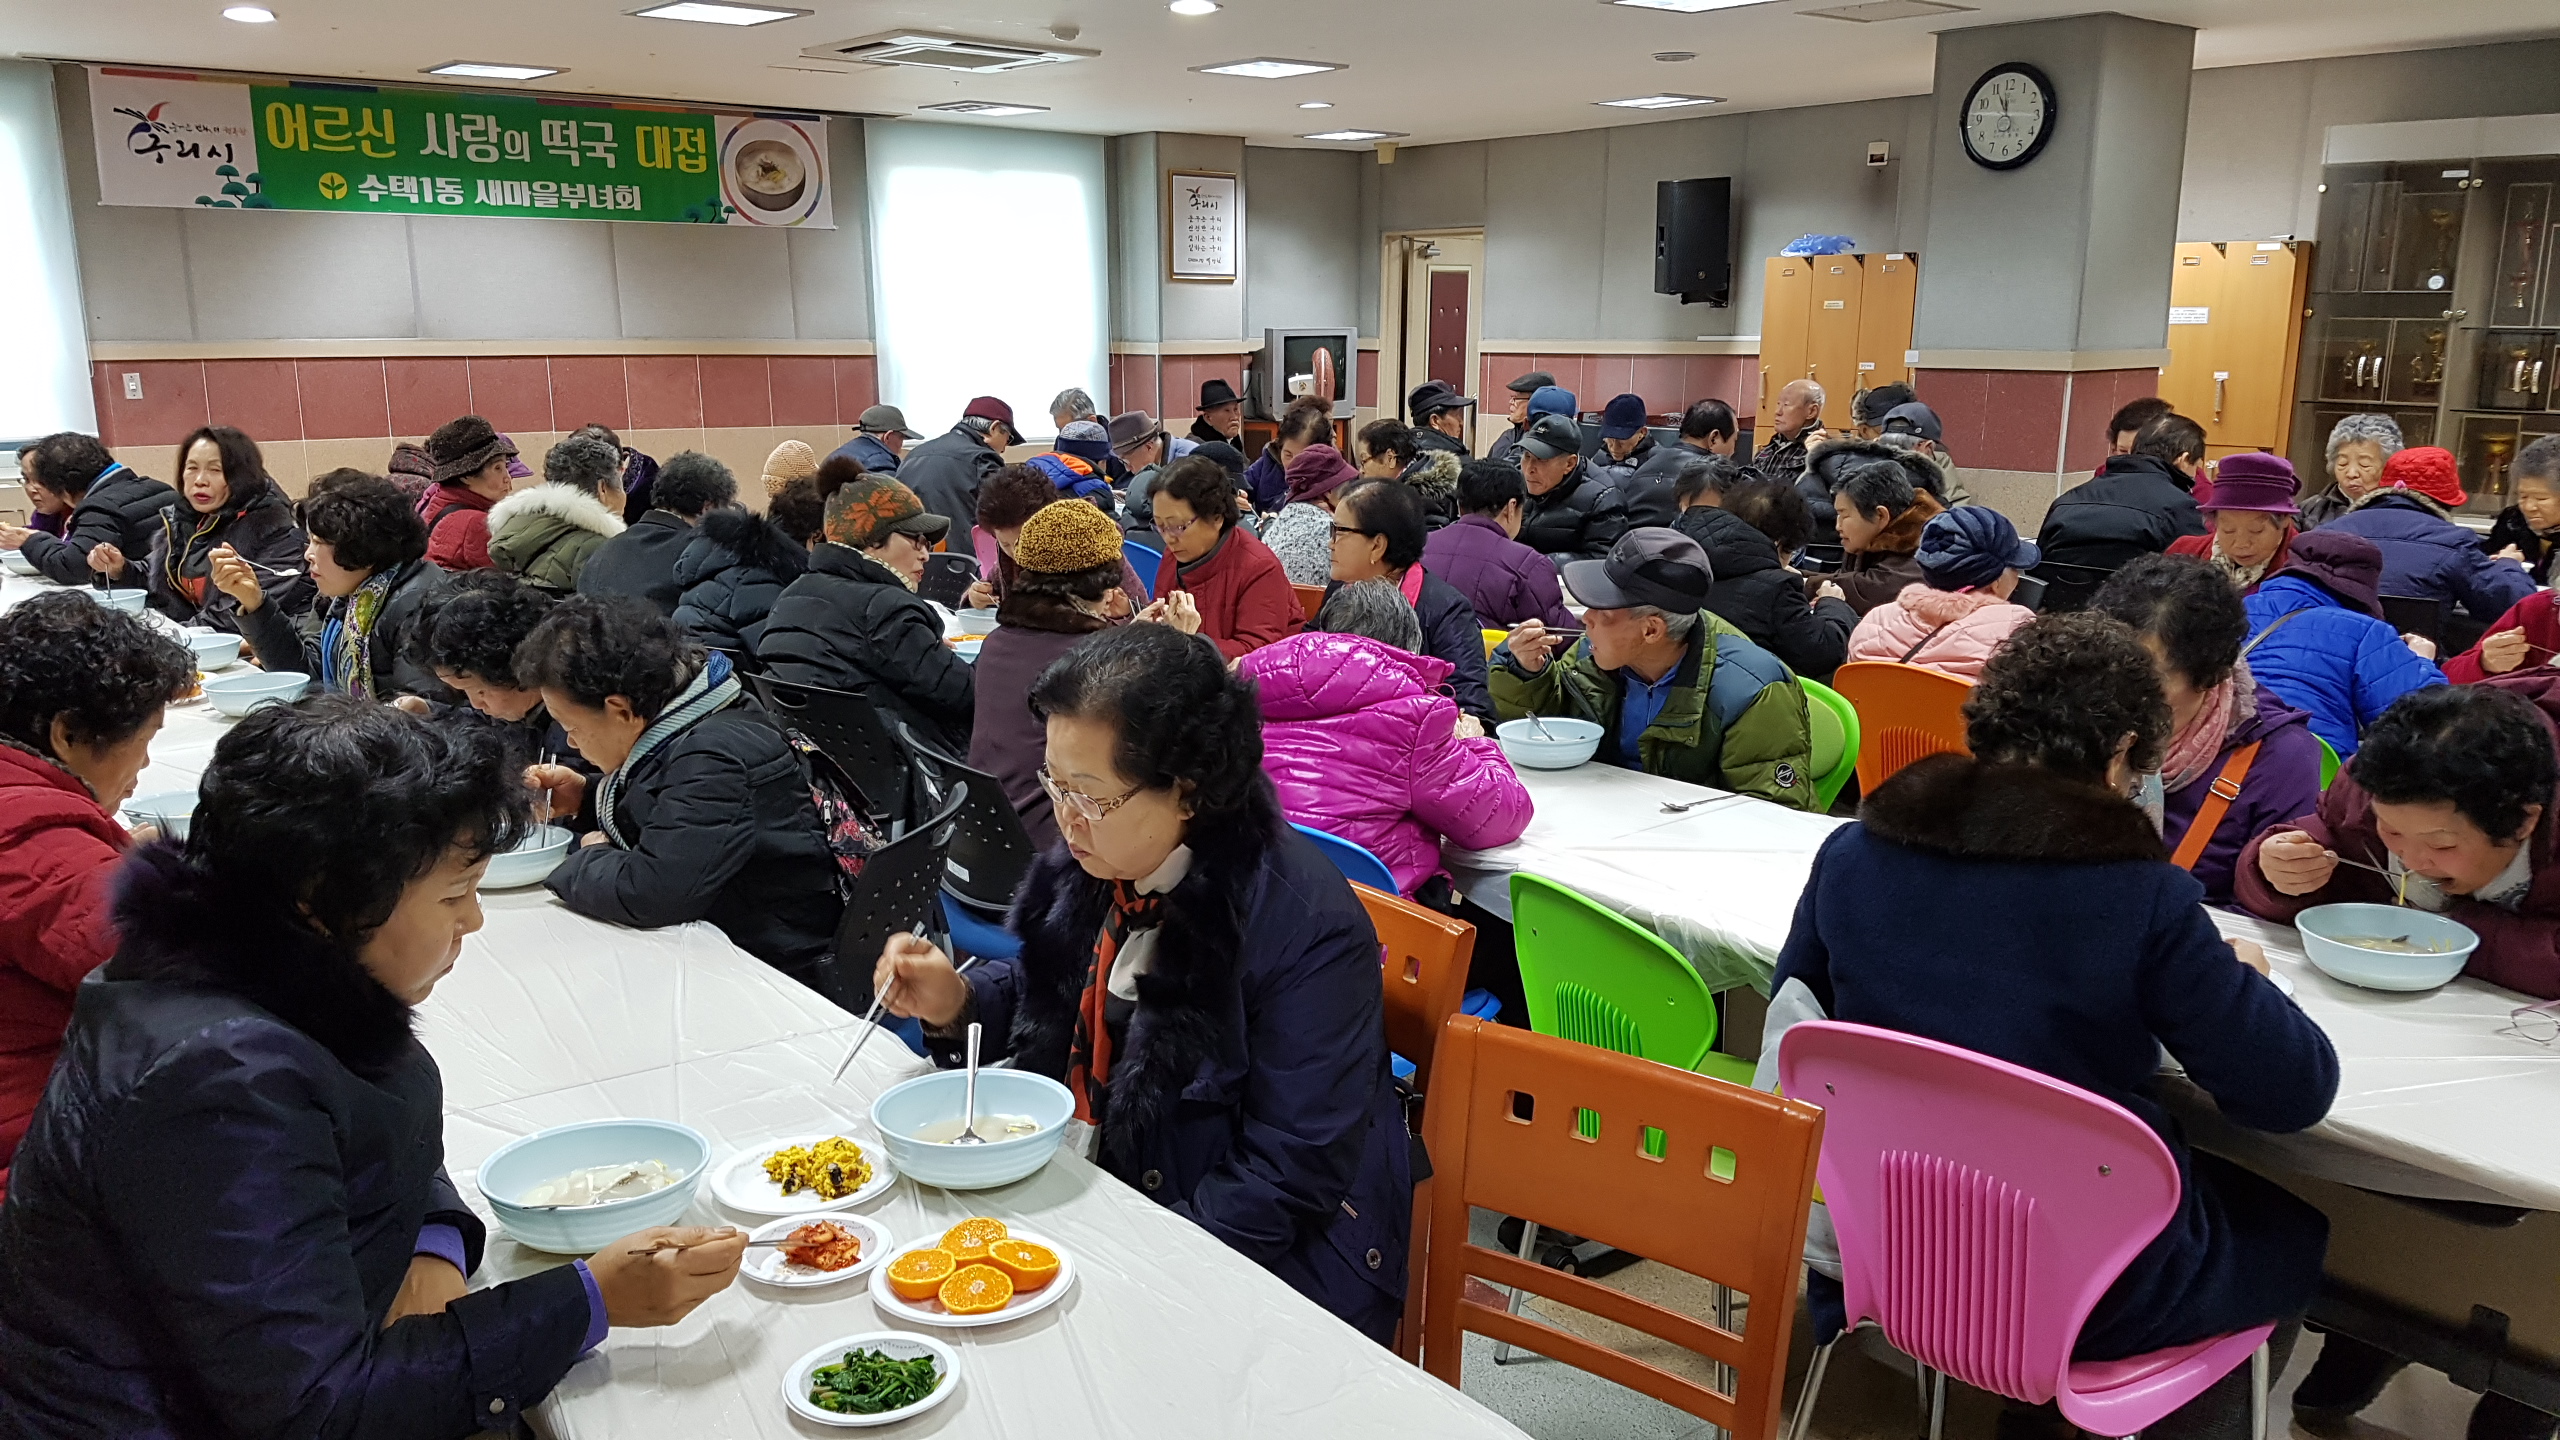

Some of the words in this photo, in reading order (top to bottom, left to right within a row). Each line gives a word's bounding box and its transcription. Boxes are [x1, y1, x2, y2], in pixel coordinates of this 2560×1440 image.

[1992, 83, 2000, 95] 11
[2005, 79, 2015, 91] 12
[2022, 82, 2026, 94] 1
[1980, 97, 1989, 110] 10
[2030, 91, 2037, 104] 2
[1976, 114, 1982, 125] 9
[2033, 109, 2040, 121] 3
[1978, 130, 1985, 142] 8
[2028, 125, 2034, 136] 4
[265, 102, 396, 158] 어르신
[420, 111, 531, 163] 사랑의
[540, 119, 618, 169] 떡국
[635, 125, 707, 173] 대접
[134, 132, 234, 164] 구리시
[1989, 142, 1995, 153] 7
[2002, 145, 2008, 156] 6
[2016, 139, 2023, 152] 5
[357, 174, 464, 206] 수택1동
[475, 178, 641, 211] 새마을부녀회
